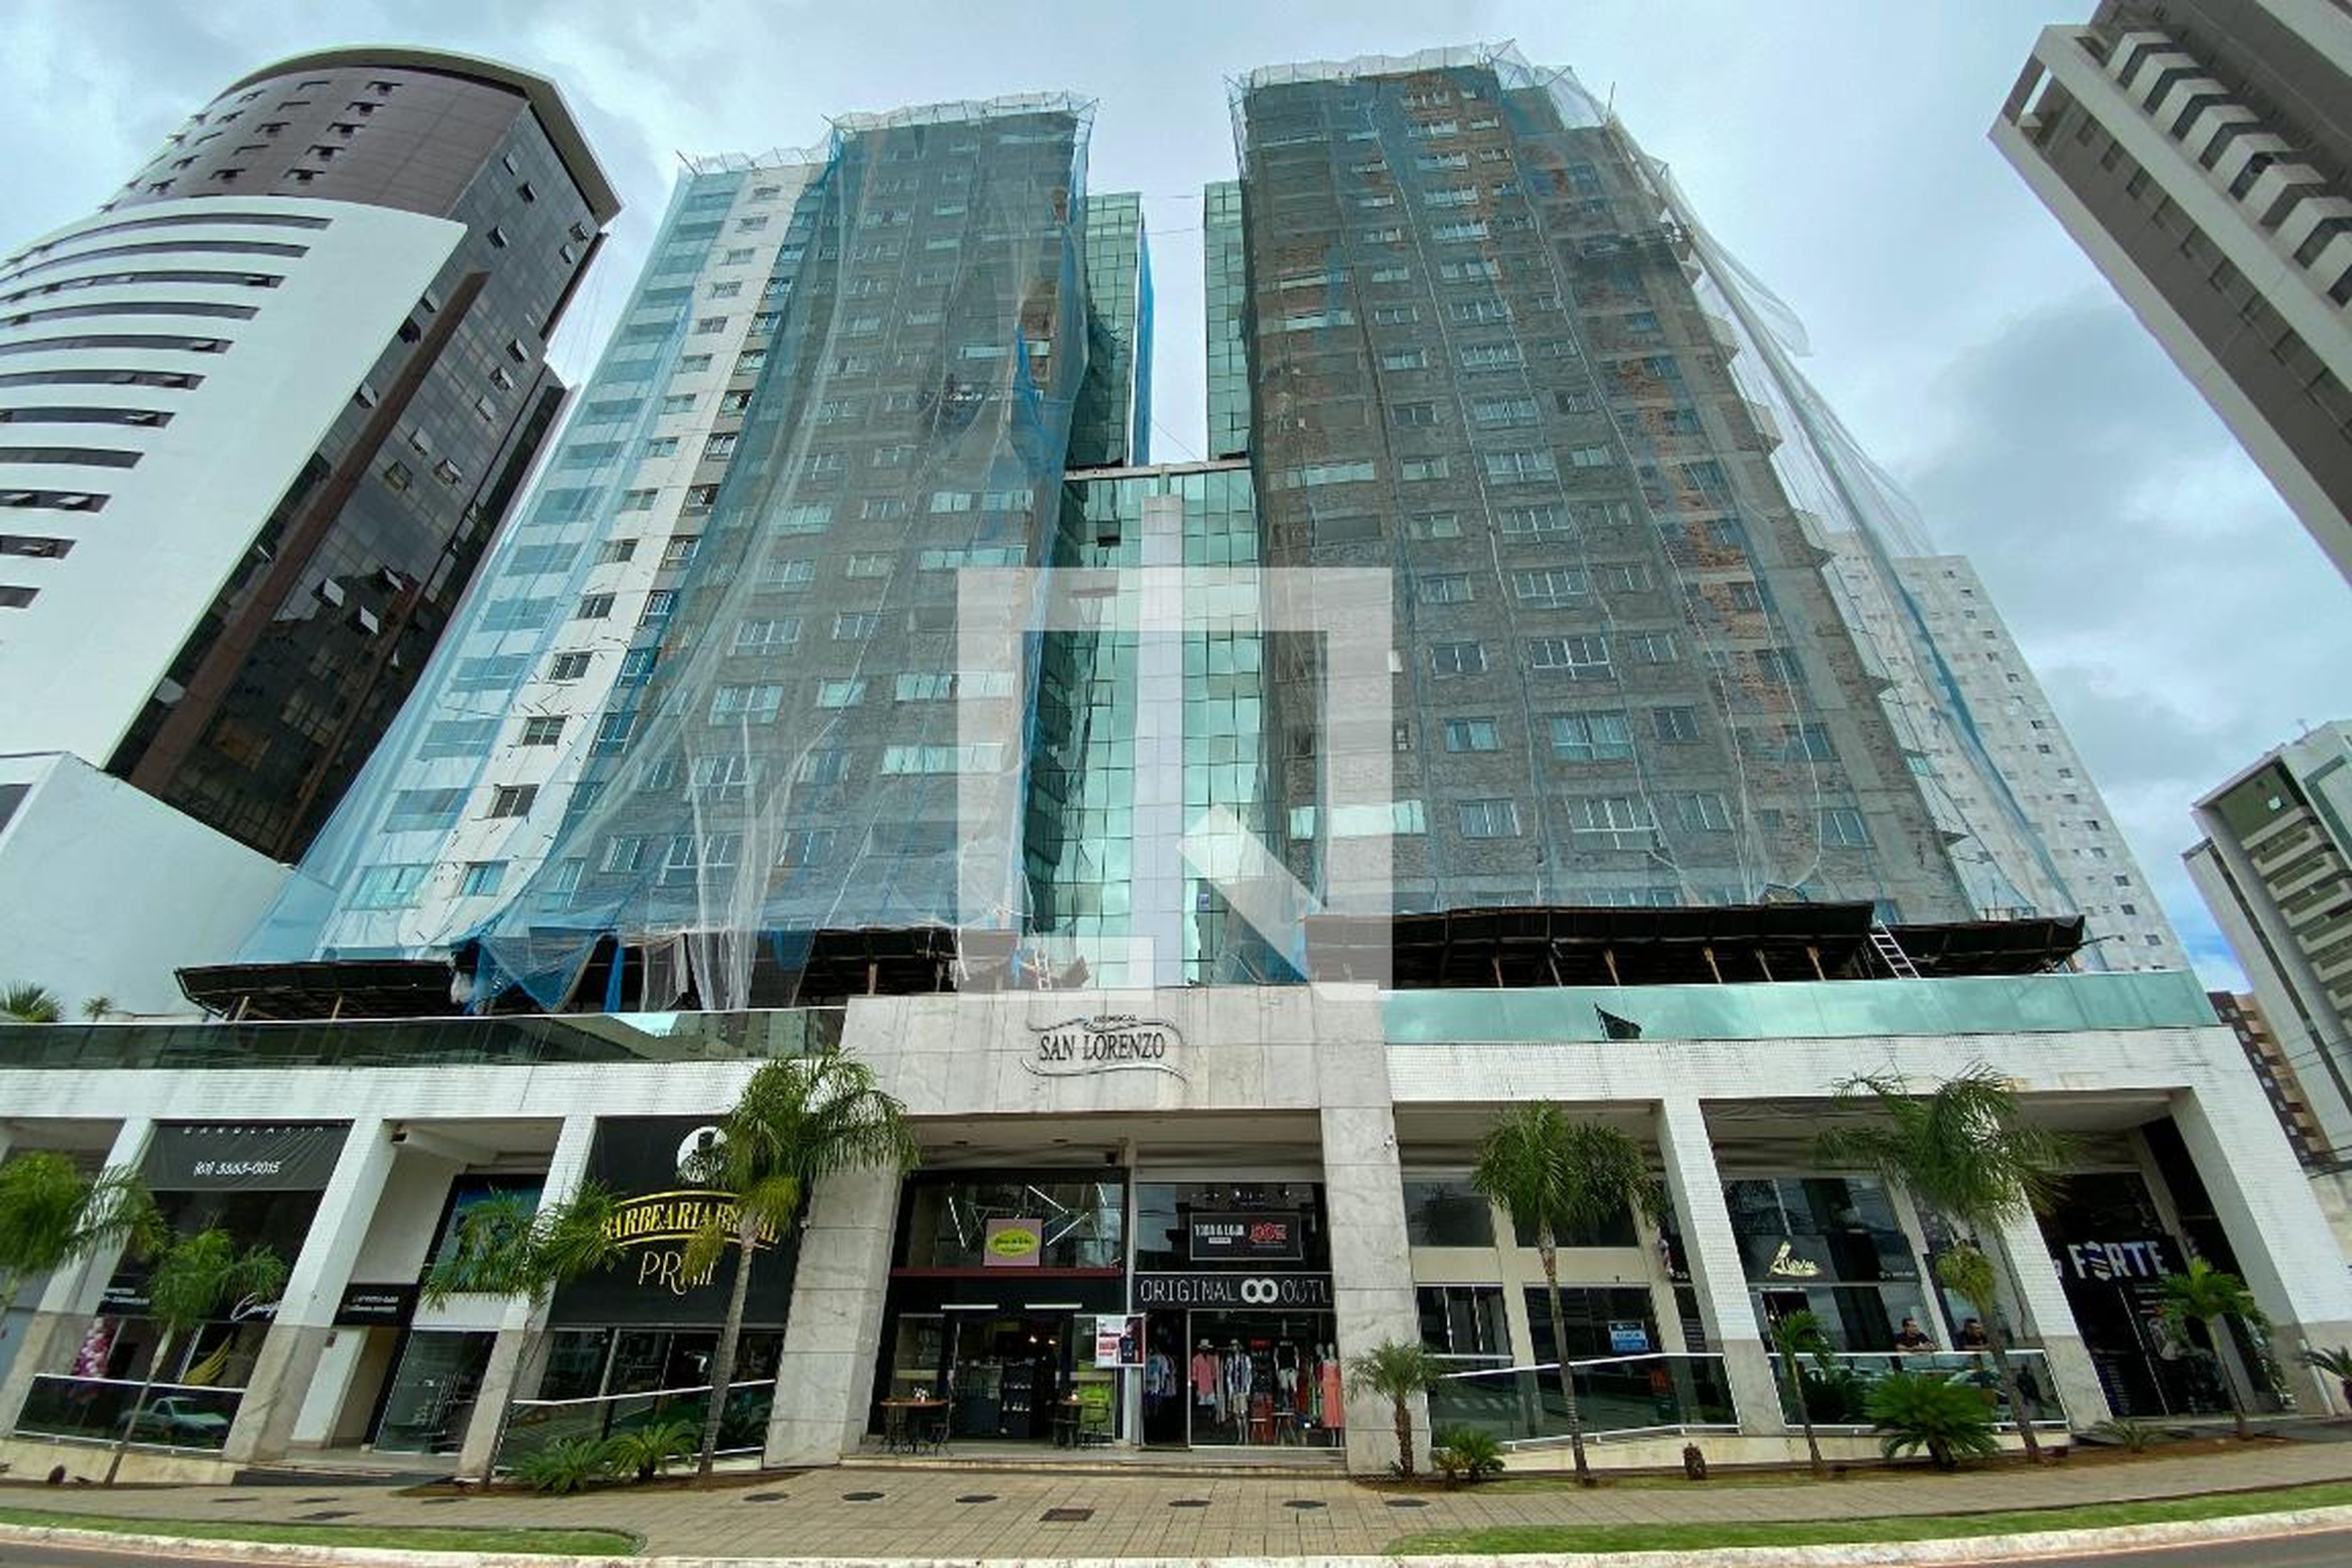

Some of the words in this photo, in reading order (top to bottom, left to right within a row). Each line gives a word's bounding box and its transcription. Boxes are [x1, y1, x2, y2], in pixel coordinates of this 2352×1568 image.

[1039, 1035, 1074, 1061] SAN
[1082, 1033, 1165, 1060] LORENZO
[2067, 1241, 2170, 1281] FORTE
[1140, 1280, 1238, 1302] ORIGINAL
